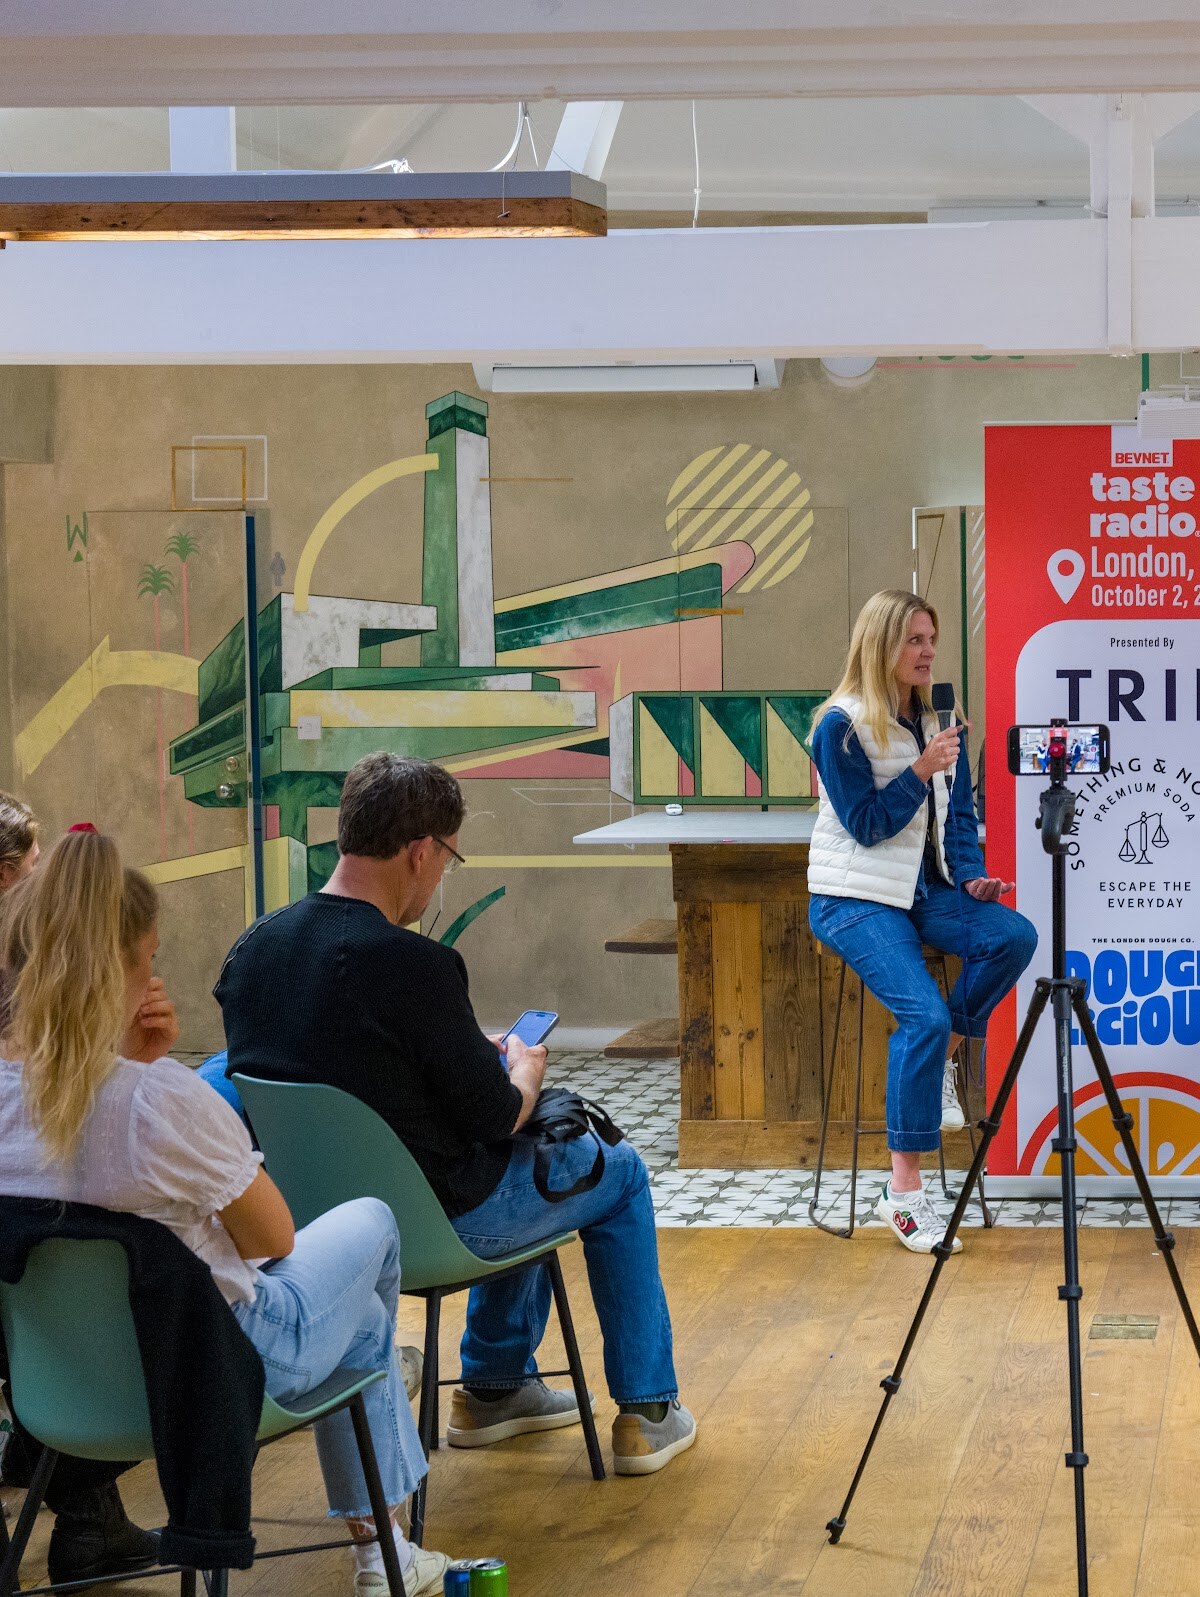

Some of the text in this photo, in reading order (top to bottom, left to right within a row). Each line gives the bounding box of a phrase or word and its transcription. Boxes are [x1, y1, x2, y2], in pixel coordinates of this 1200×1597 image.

[1115, 452, 1170, 464] BEVNET
[1090, 472, 1196, 502] taste
[1091, 545, 1195, 581] London,
[1091, 584, 1168, 607] October
[1172, 584, 1189, 609] 2,
[1110, 637, 1175, 650] Presented By
[1068, 758, 1143, 871] SOMETHING
[1153, 758, 1167, 774] &
[1093, 782, 1196, 822] PREMIUM SODA
[1099, 881, 1192, 892] ESCAPE THE
[1107, 898, 1184, 908] EVERYDAY
